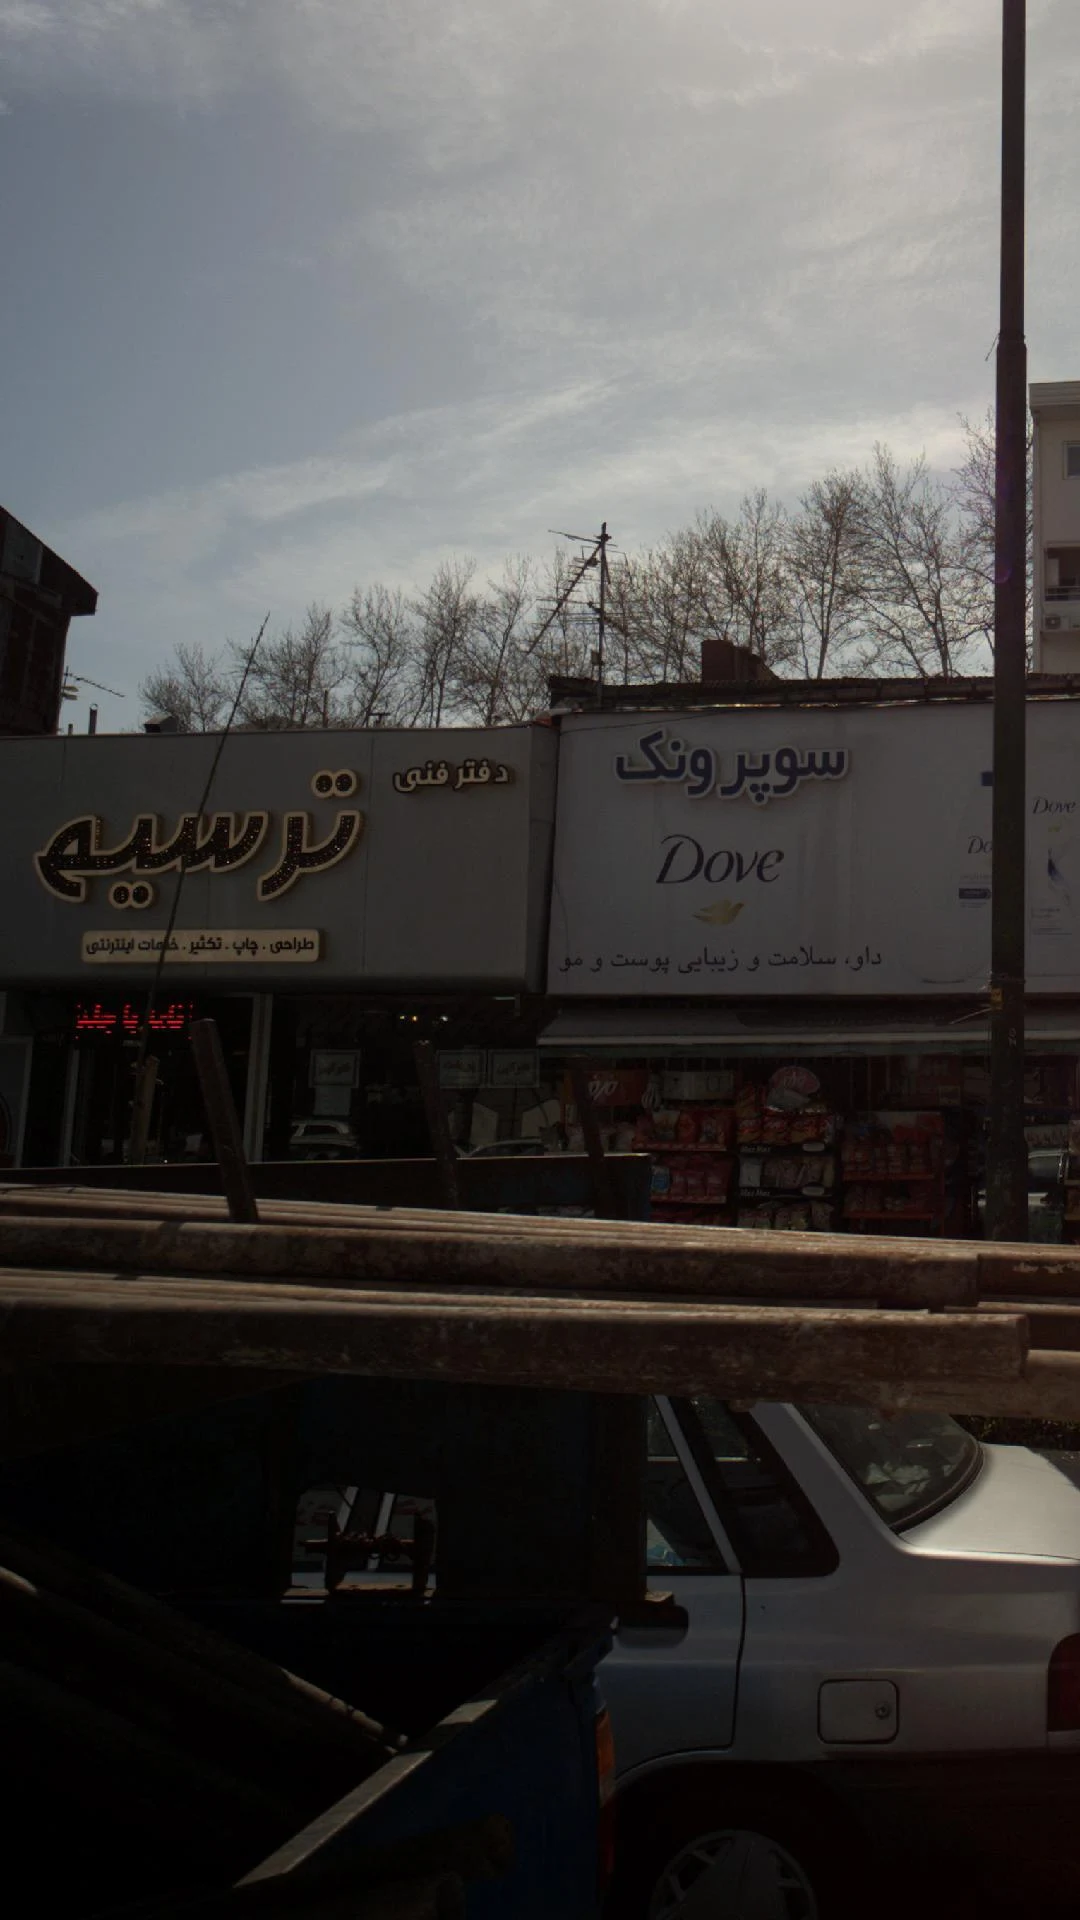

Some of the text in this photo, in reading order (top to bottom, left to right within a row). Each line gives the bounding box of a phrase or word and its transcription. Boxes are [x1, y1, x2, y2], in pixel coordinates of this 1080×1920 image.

[393, 759, 509, 793] دفتر فنی
[616, 729, 847, 804] سوپر ونک
[1032, 796, 1077, 815] Dove
[967, 835, 993, 854] Do
[656, 834, 785, 883] Dove
[86, 936, 135, 955] اینترنتی
[188, 935, 223, 954] تکثیر
[232, 936, 259, 957] چاپ
[270, 936, 315, 954] طراحی
[559, 955, 584, 973] مو
[590, 956, 603, 973] و
[610, 954, 671, 974] پوست
[678, 947, 740, 974] زیبایی
[746, 954, 760, 972] و
[767, 945, 837, 967] سلامت
